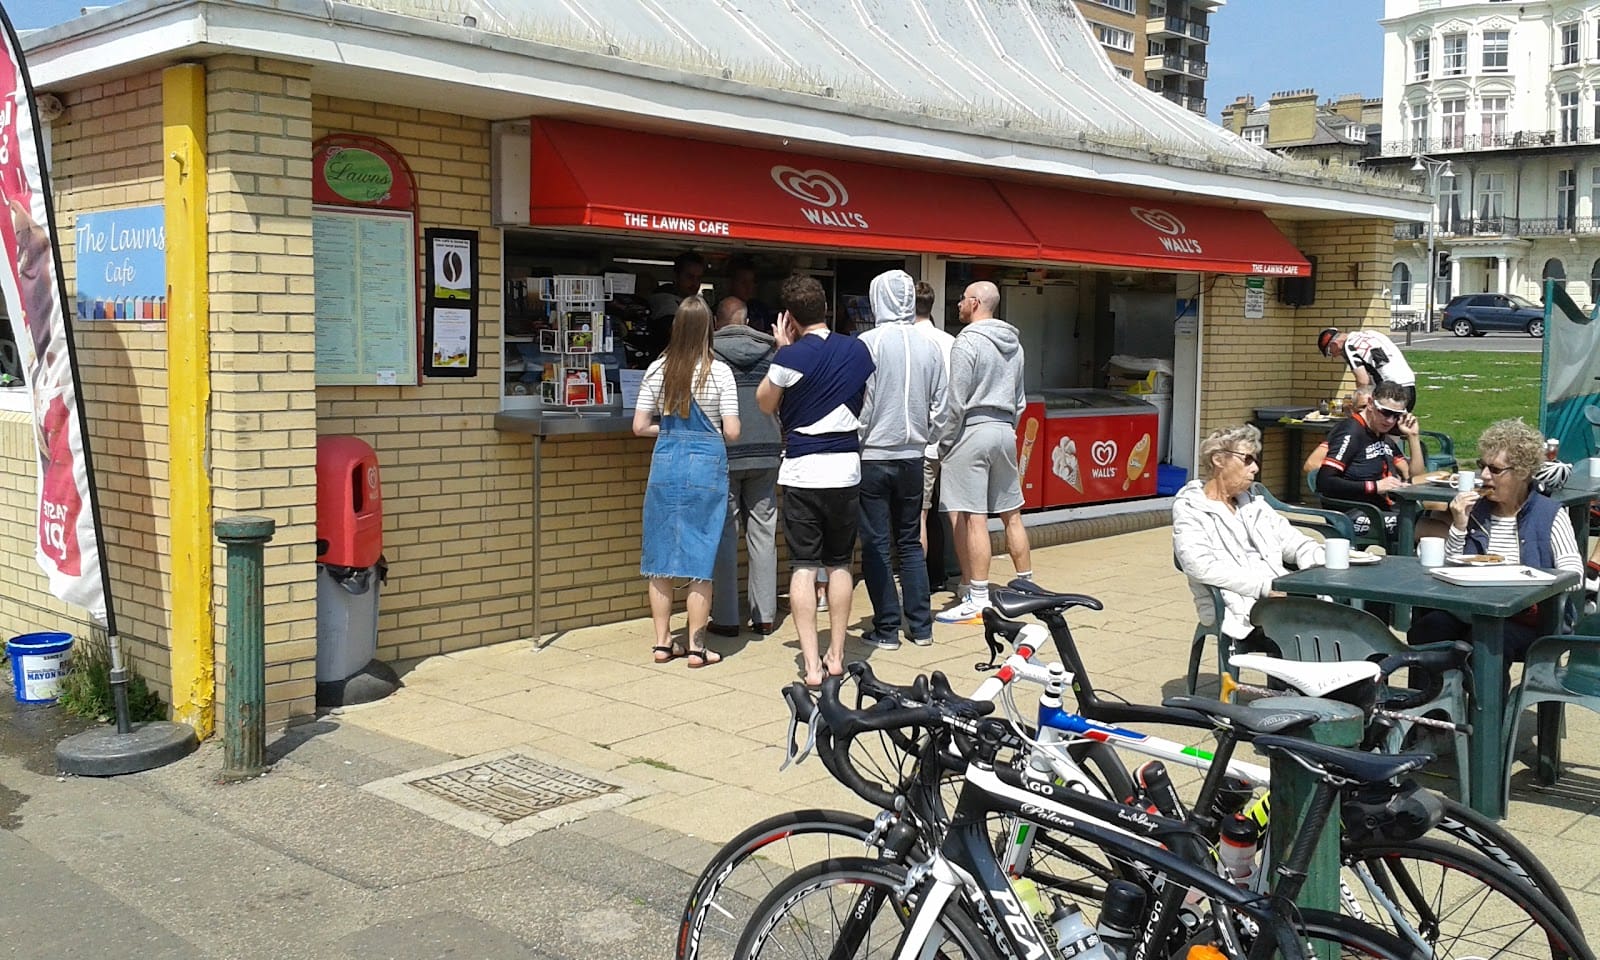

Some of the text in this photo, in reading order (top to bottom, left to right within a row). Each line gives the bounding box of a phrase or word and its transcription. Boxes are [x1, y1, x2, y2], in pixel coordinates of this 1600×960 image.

[327, 161, 389, 185] Lawns
[624, 212, 729, 235] THE LAWNS CAFE
[801, 207, 868, 229] WALL'S
[77, 221, 166, 254] The Lawns
[1159, 236, 1203, 254] WALL'S
[105, 257, 136, 287] Cafe
[1252, 263, 1298, 275] THE LAWNS CAFE
[1091, 467, 1116, 478] WALL'S
